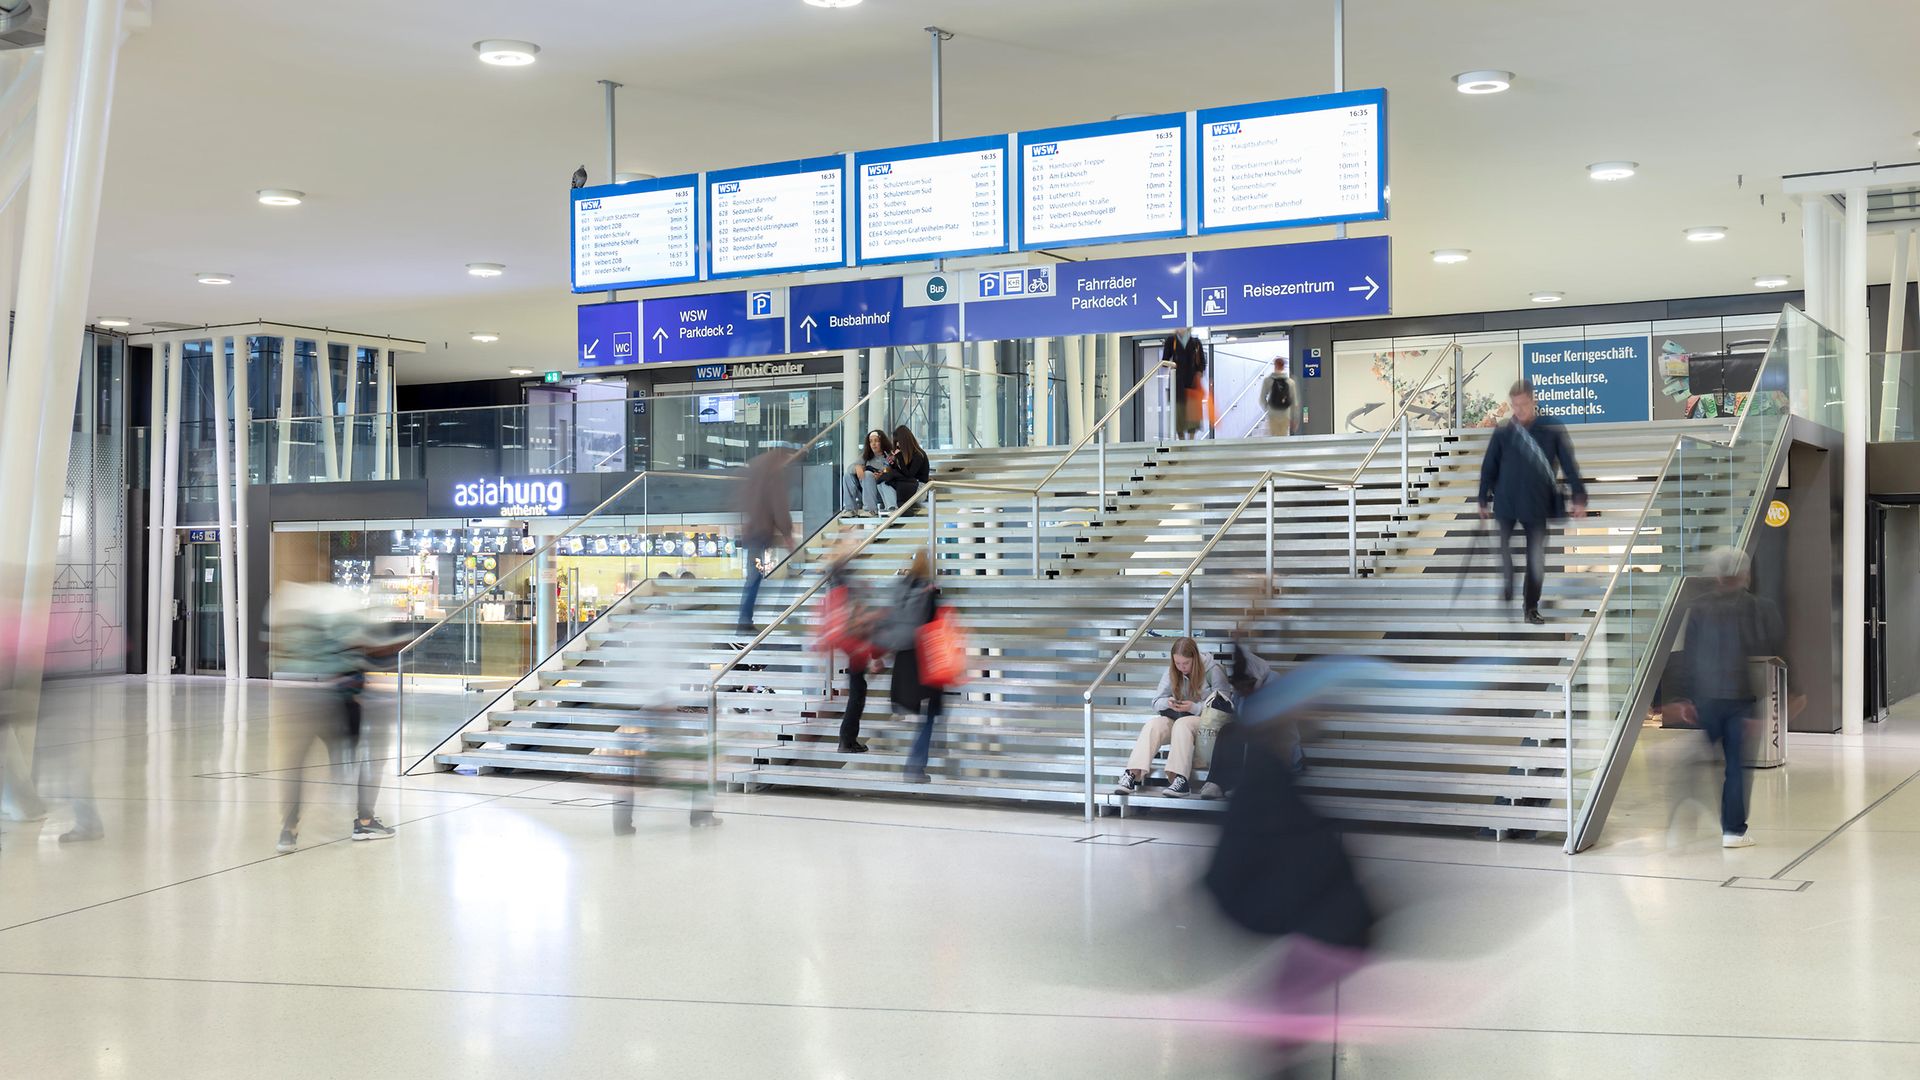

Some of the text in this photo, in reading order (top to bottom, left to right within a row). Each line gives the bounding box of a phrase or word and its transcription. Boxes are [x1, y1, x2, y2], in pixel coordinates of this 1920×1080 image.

[929, 283, 945, 294] Bus
[1077, 276, 1137, 291] Fahrräder
[1243, 281, 1335, 298] Reisezentrum
[1072, 294, 1138, 310] Parkdeck 1
[679, 310, 708, 322] WSW
[829, 312, 890, 328] Busbahnhof
[679, 325, 734, 339] Parkdeck 2
[616, 342, 630, 354] WC
[1531, 346, 1638, 363] Unser Kerngeschäft.
[733, 361, 804, 377] MobiCenter
[1309, 368, 1315, 376] 3
[1531, 372, 1608, 386] Wechselkurse,
[1532, 388, 1598, 401] Edelmetalle,
[1533, 402, 1605, 417] Reiseschecks.
[454, 476, 563, 511] asiahung
[1768, 508, 1785, 520] WC
[192, 532, 204, 540] 4+5
